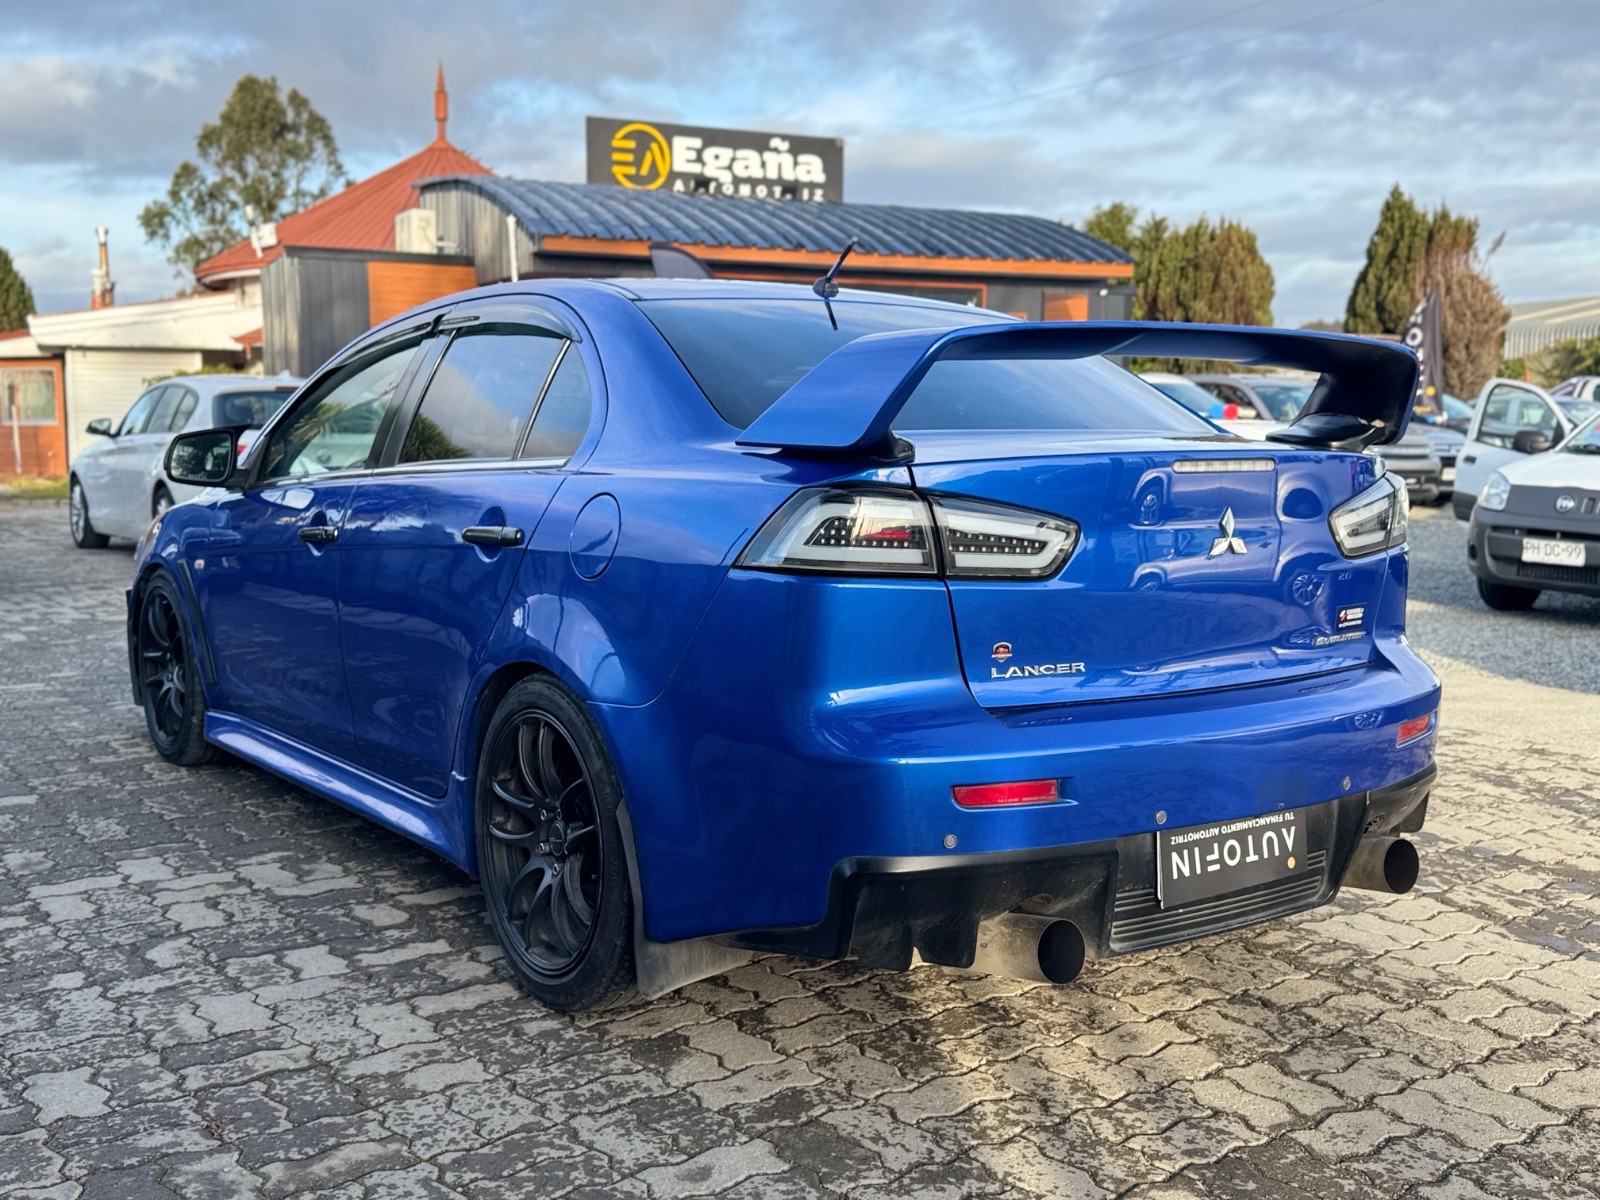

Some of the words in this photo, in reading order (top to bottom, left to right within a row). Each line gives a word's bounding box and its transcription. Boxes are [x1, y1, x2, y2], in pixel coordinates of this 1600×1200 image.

[671, 135, 827, 184] Egaña
[991, 663, 1086, 679] LANCER
[1220, 814, 1284, 835] FINANCIAMIENTO
[1285, 811, 1295, 822] TU
[1170, 826, 1220, 846] AUTOMOTRIZ
[1171, 825, 1296, 879] AUTOFIN
